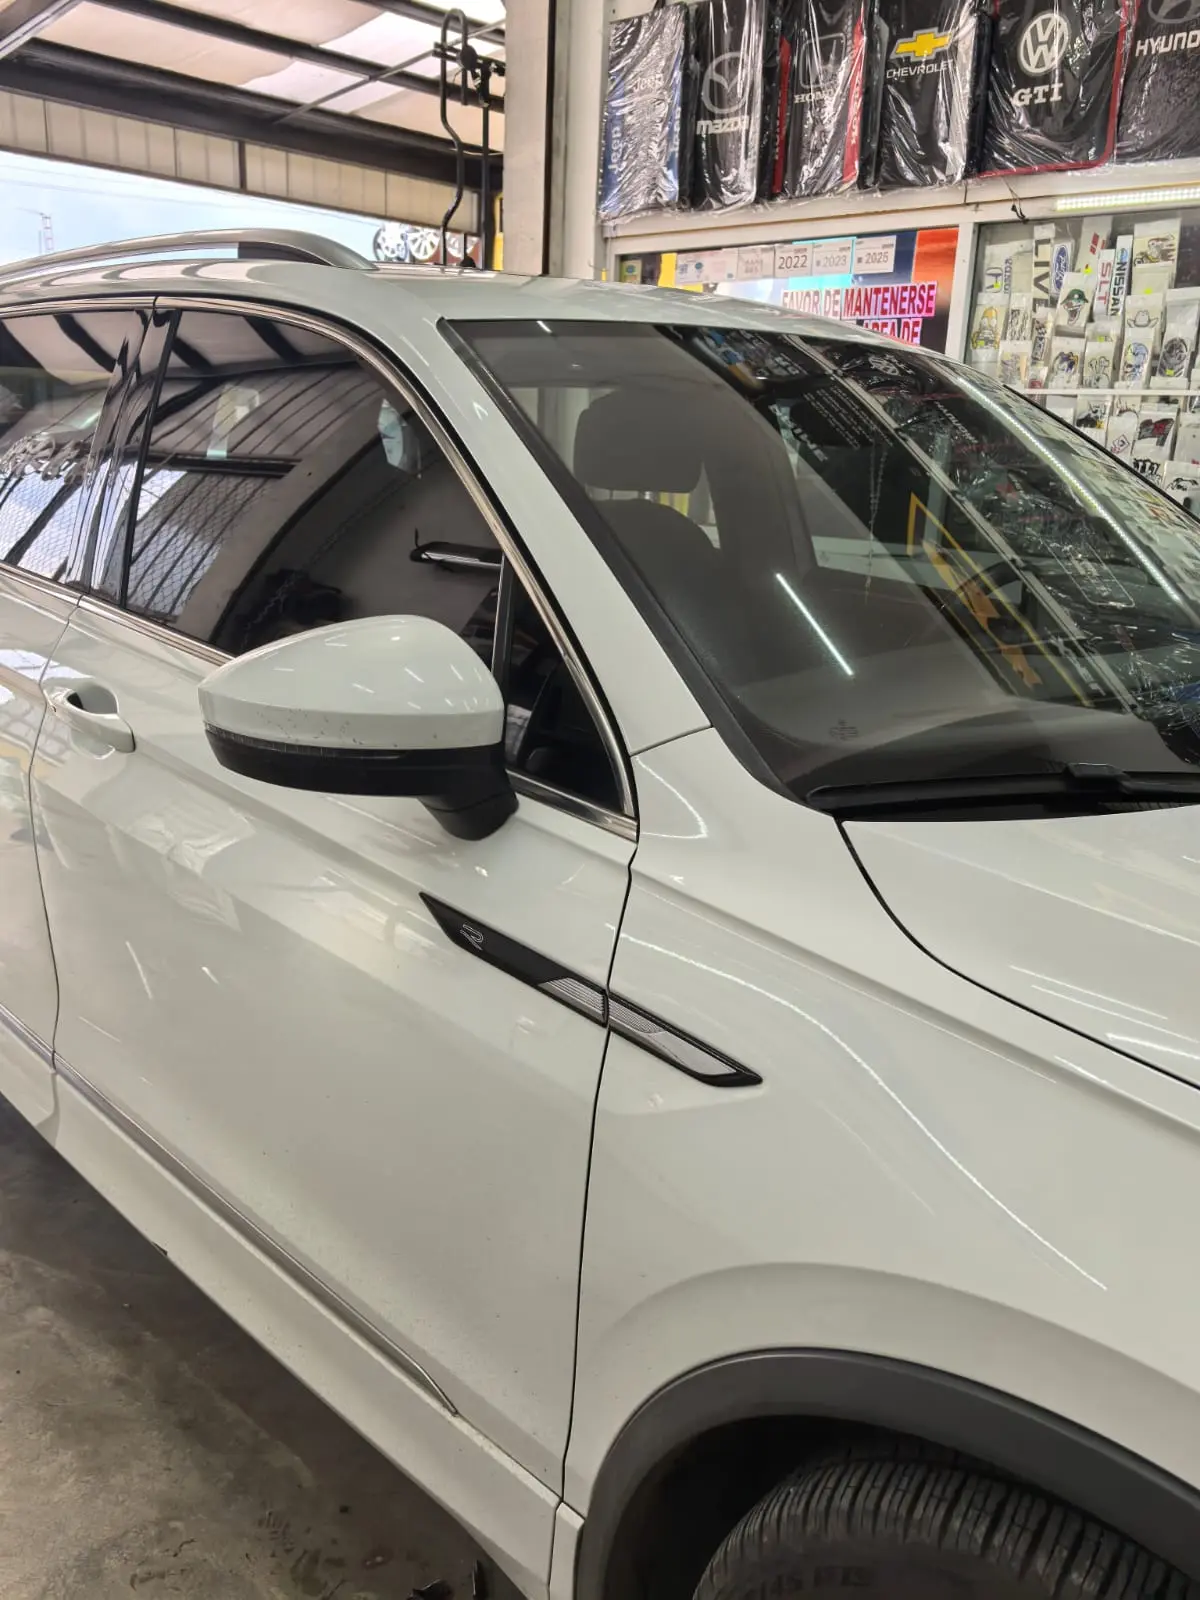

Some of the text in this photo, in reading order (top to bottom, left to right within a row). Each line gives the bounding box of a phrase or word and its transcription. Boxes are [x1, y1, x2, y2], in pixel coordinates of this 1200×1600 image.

[886, 58, 954, 79] CHEVROLET
[794, 88, 837, 104] HOND
[1011, 82, 1064, 107] GTI
[777, 254, 809, 270] 2022
[822, 254, 848, 268] 2023
[1096, 261, 1112, 305] SLT
[1110, 261, 1128, 317] NISSAN
[823, 288, 841, 317] DE
[844, 283, 936, 317] MANTENERSE
[901, 318, 921, 344] DE
